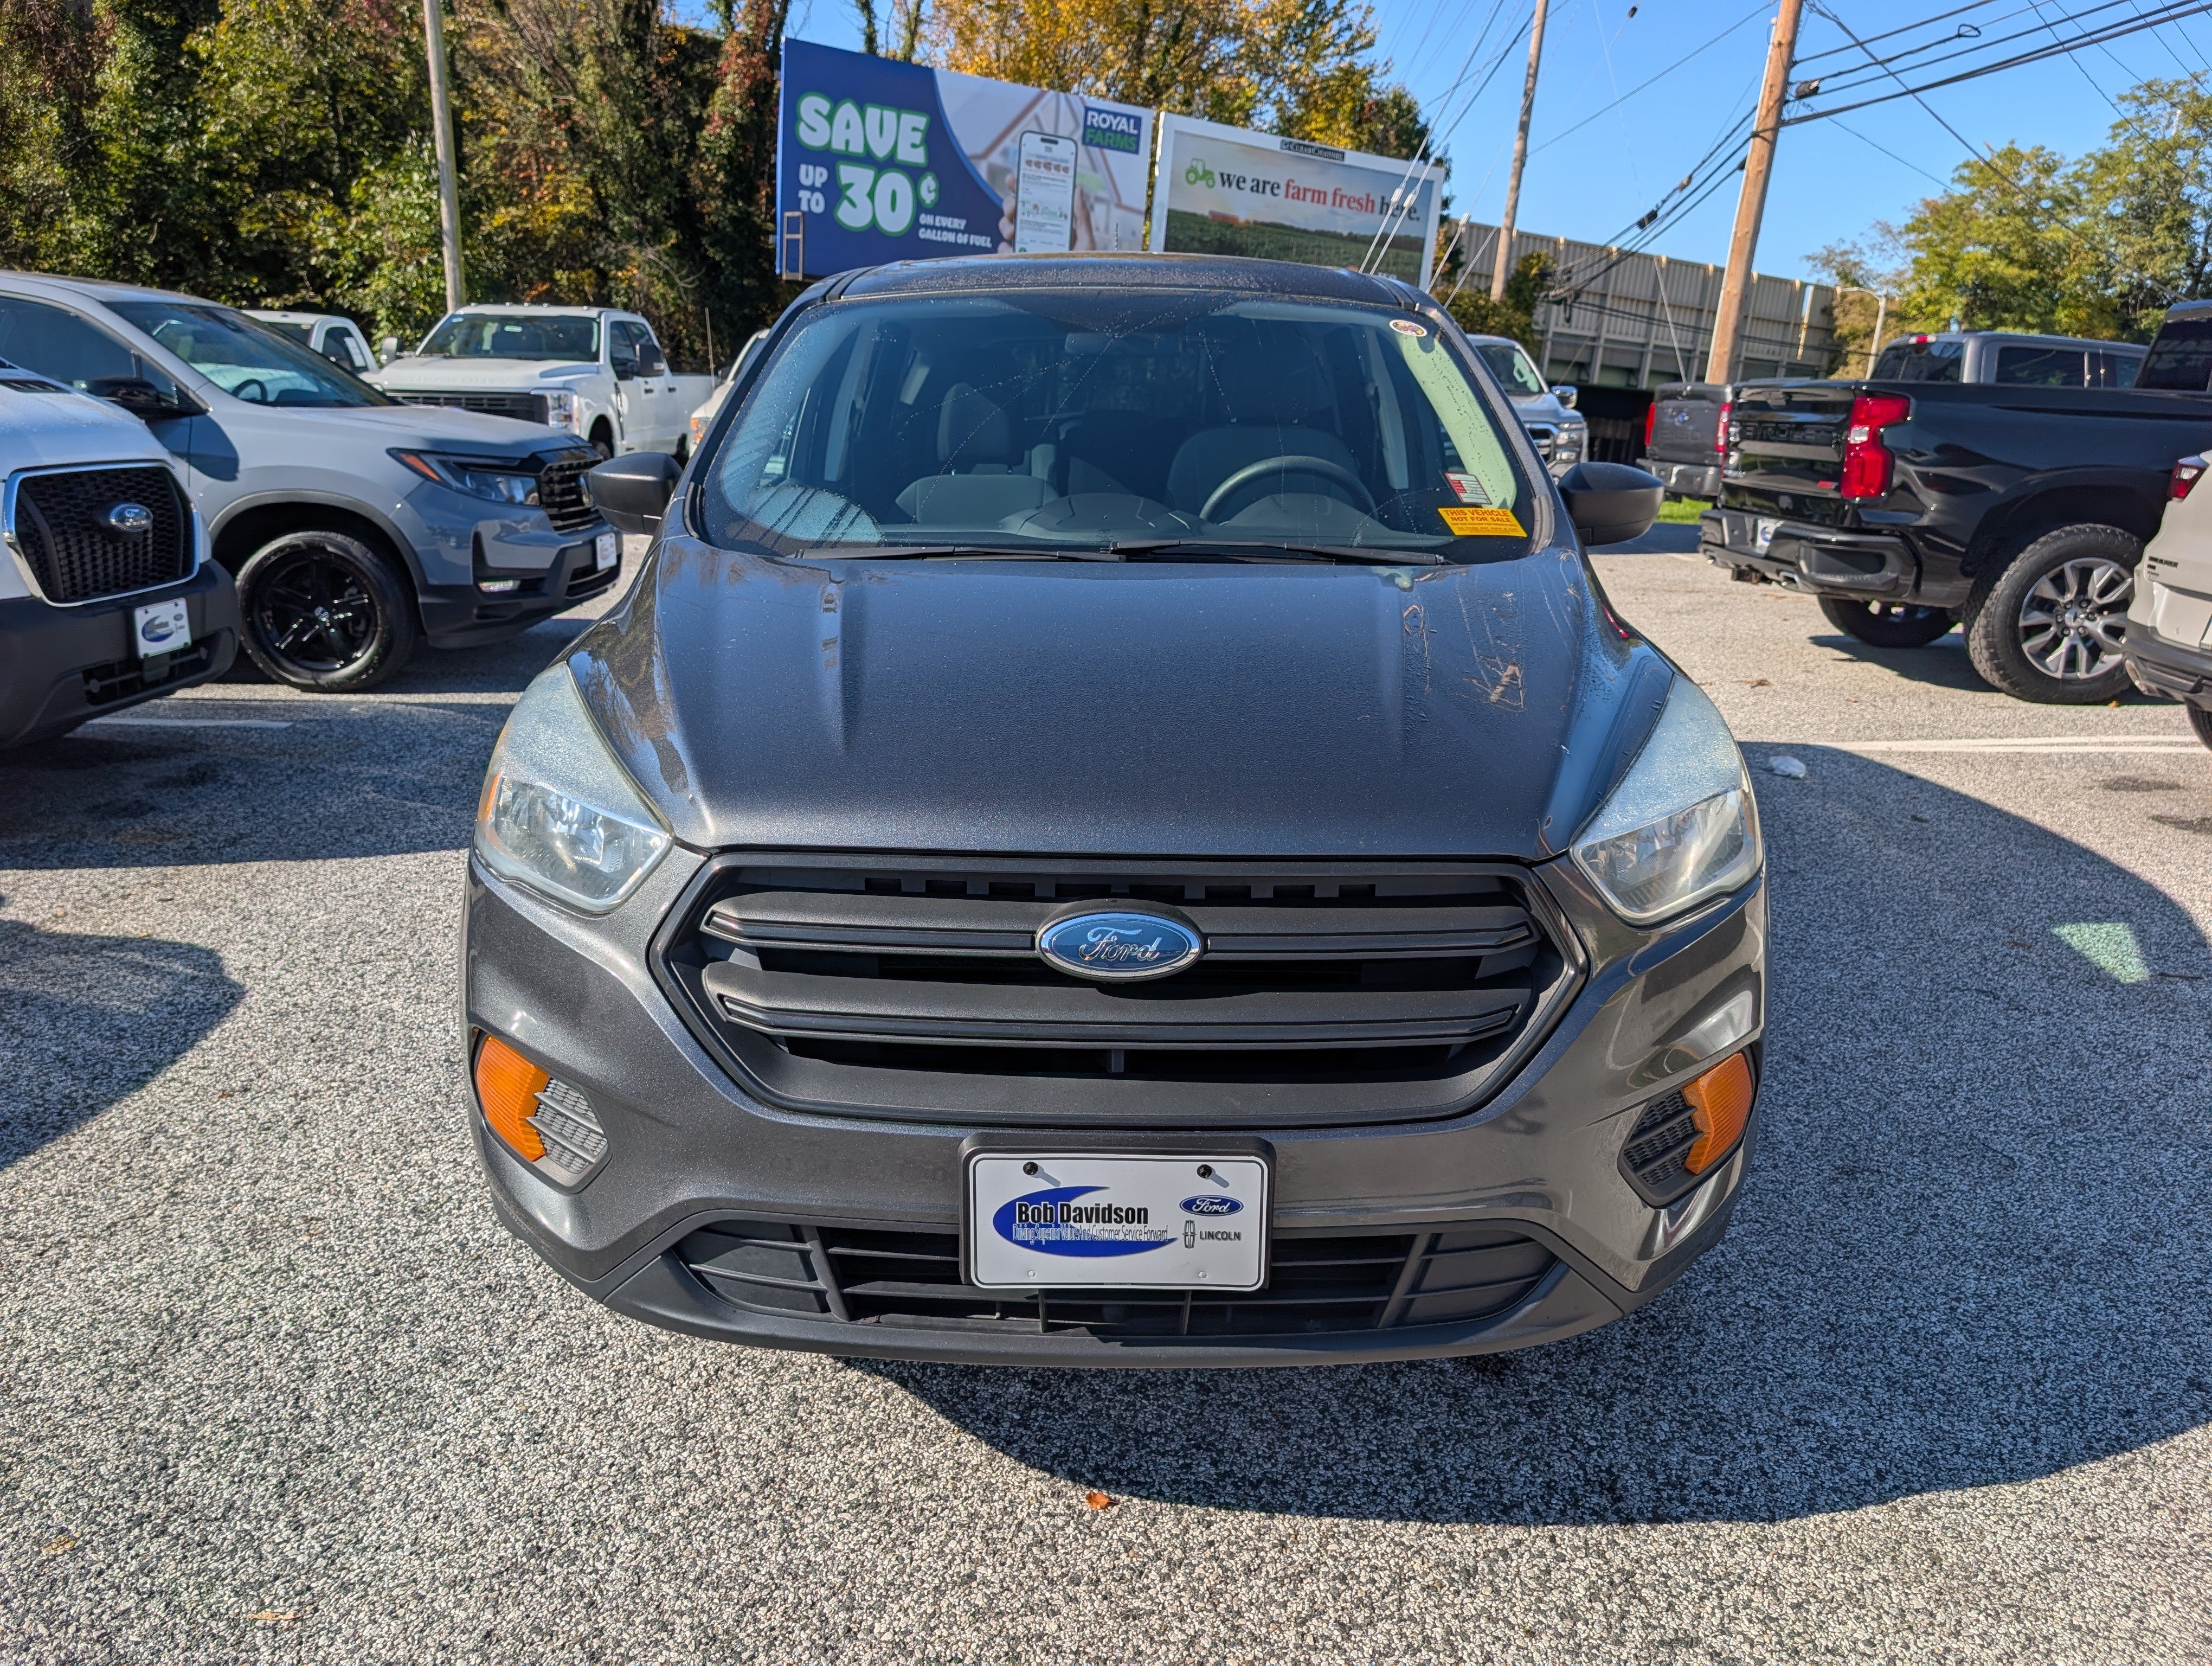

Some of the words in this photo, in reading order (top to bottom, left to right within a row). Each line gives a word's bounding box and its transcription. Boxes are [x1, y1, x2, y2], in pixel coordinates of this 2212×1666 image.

[795, 92, 930, 166] SAVE
[1086, 111, 1139, 134] ROYAL
[1085, 127, 1136, 151] FARMS
[799, 163, 828, 188] UP
[798, 190, 826, 214] TO
[1219, 171, 1245, 191] we
[1250, 176, 1280, 196] are
[1284, 179, 1327, 206] farm
[1332, 188, 1375, 214] fresh
[919, 213, 934, 226] ON
[935, 215, 967, 230] EVERY
[918, 228, 956, 244] GALLON
[956, 233, 969, 245] OF
[969, 234, 993, 248] FUEL
[1078, 926, 1163, 961] Ford
[1016, 1201, 1056, 1225] Bob
[1058, 1201, 1148, 1225] Davidson
[1192, 1197, 1231, 1213] Ford
[1013, 1223, 1035, 1245] Driving
[1035, 1223, 1061, 1245] Superior
[1061, 1224, 1079, 1241] Value
[1079, 1225, 1091, 1241] And
[1091, 1225, 1121, 1241] Customer
[1121, 1225, 1143, 1241] Service
[1143, 1225, 1168, 1241] Forward
[1199, 1230, 1242, 1241] LINCOLN
